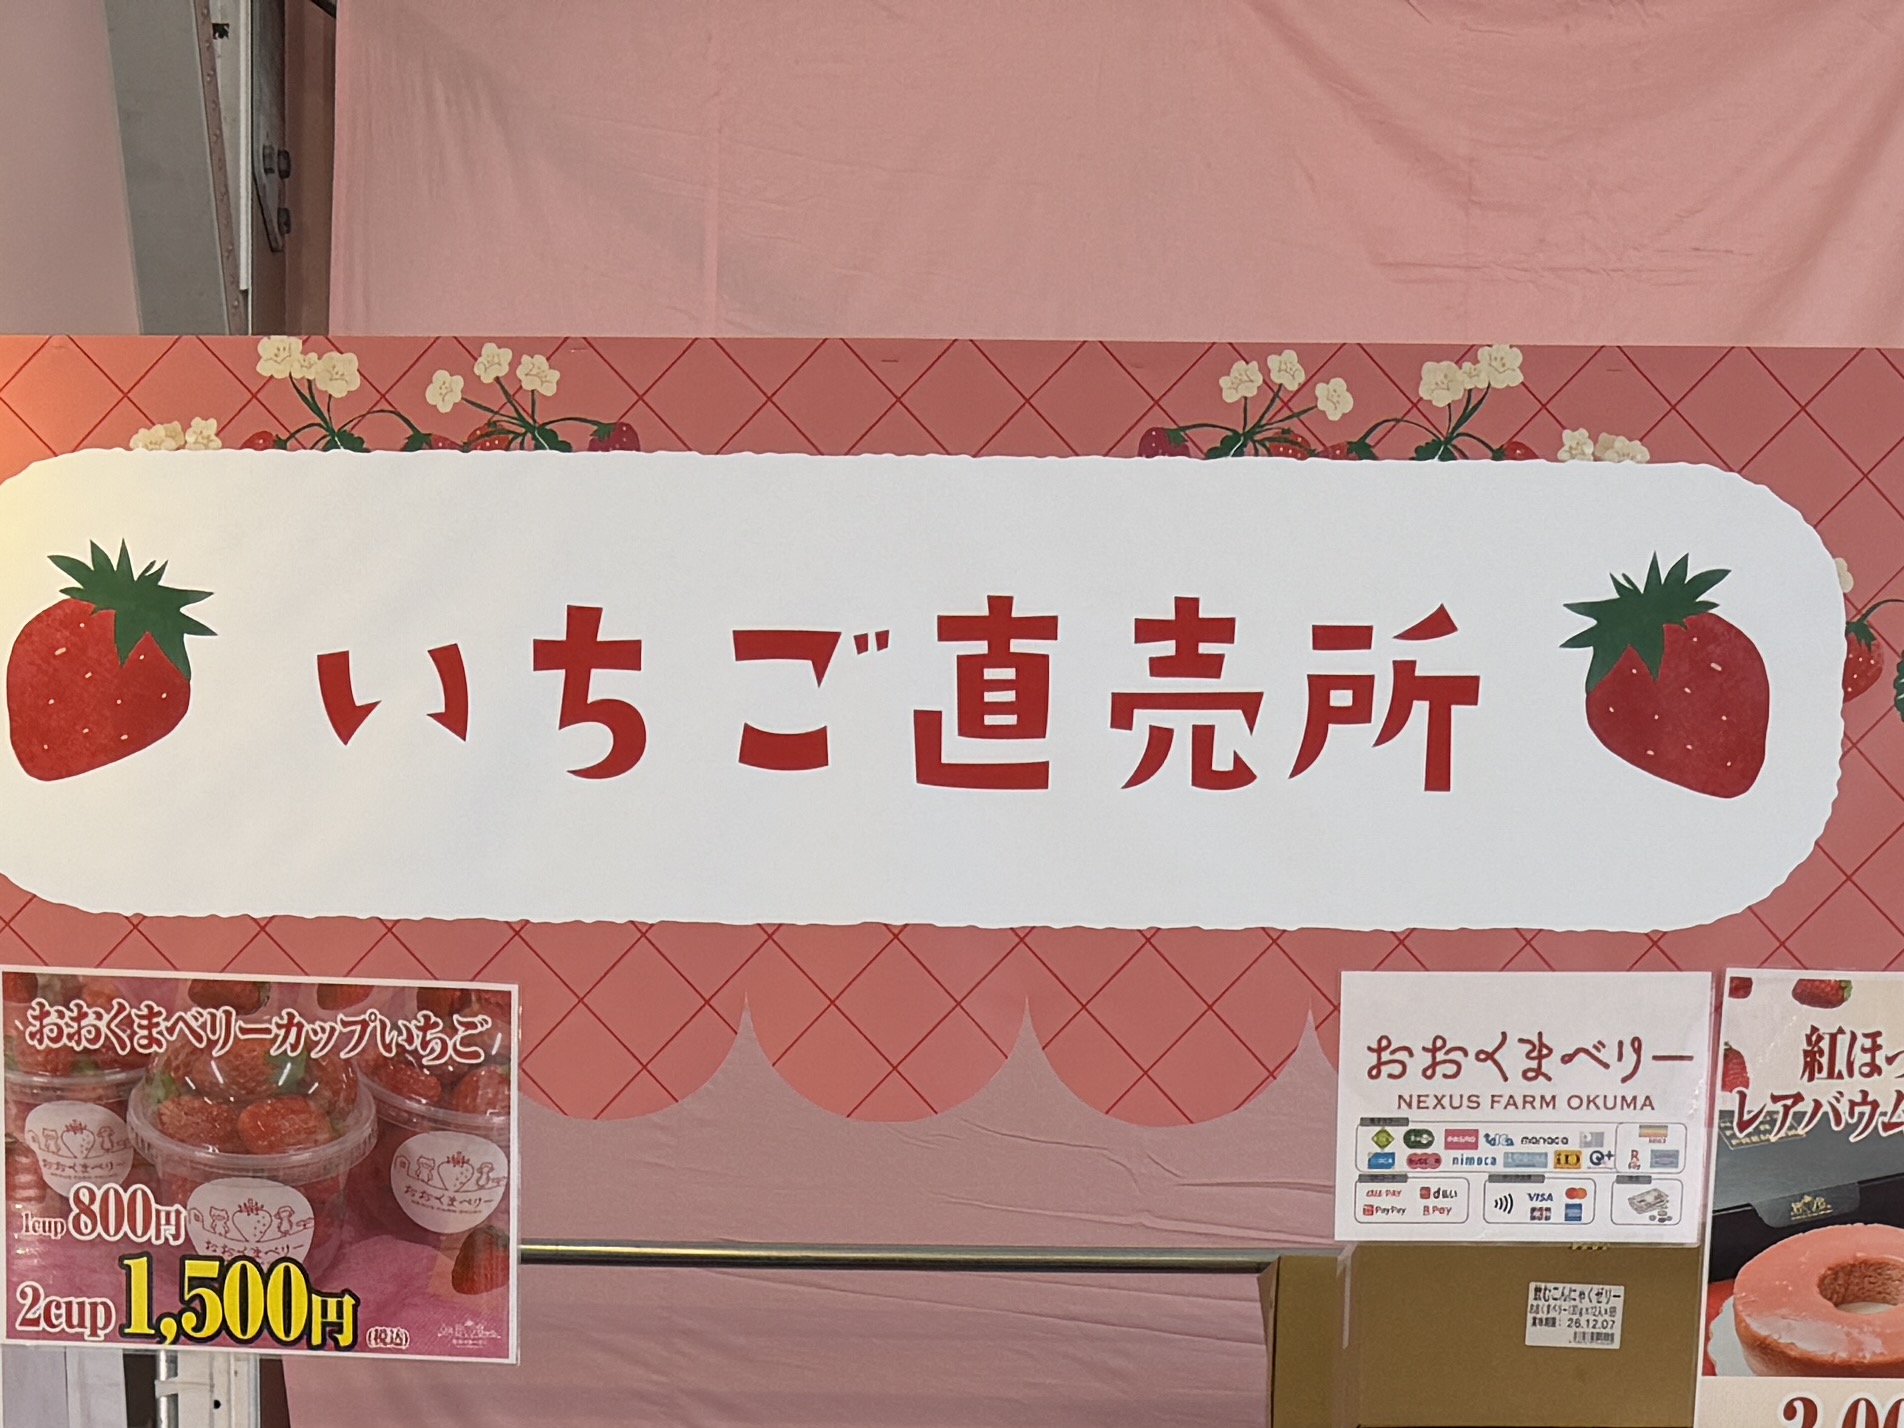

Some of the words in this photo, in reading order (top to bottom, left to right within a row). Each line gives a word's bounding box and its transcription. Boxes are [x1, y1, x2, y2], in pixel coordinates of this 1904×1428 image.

[317, 594, 1479, 794] いちご直売所
[25, 1000, 492, 1065] おおくまベリーカップいちご
[1366, 1031, 1694, 1083] おおくまベリー
[1397, 1094, 1481, 1111] NEXUS
[1490, 1094, 1557, 1111] FARM
[1567, 1095, 1655, 1112] OKUMA
[1452, 1154, 1497, 1166] nimoca
[21, 1210, 65, 1238] 1cup
[68, 1182, 188, 1245] 800円
[1527, 1192, 1553, 1202] VISA
[16, 1283, 114, 1340] 2cup
[120, 1252, 360, 1350] 1,500円
[1567, 1318, 1616, 1329] 26.12.07
